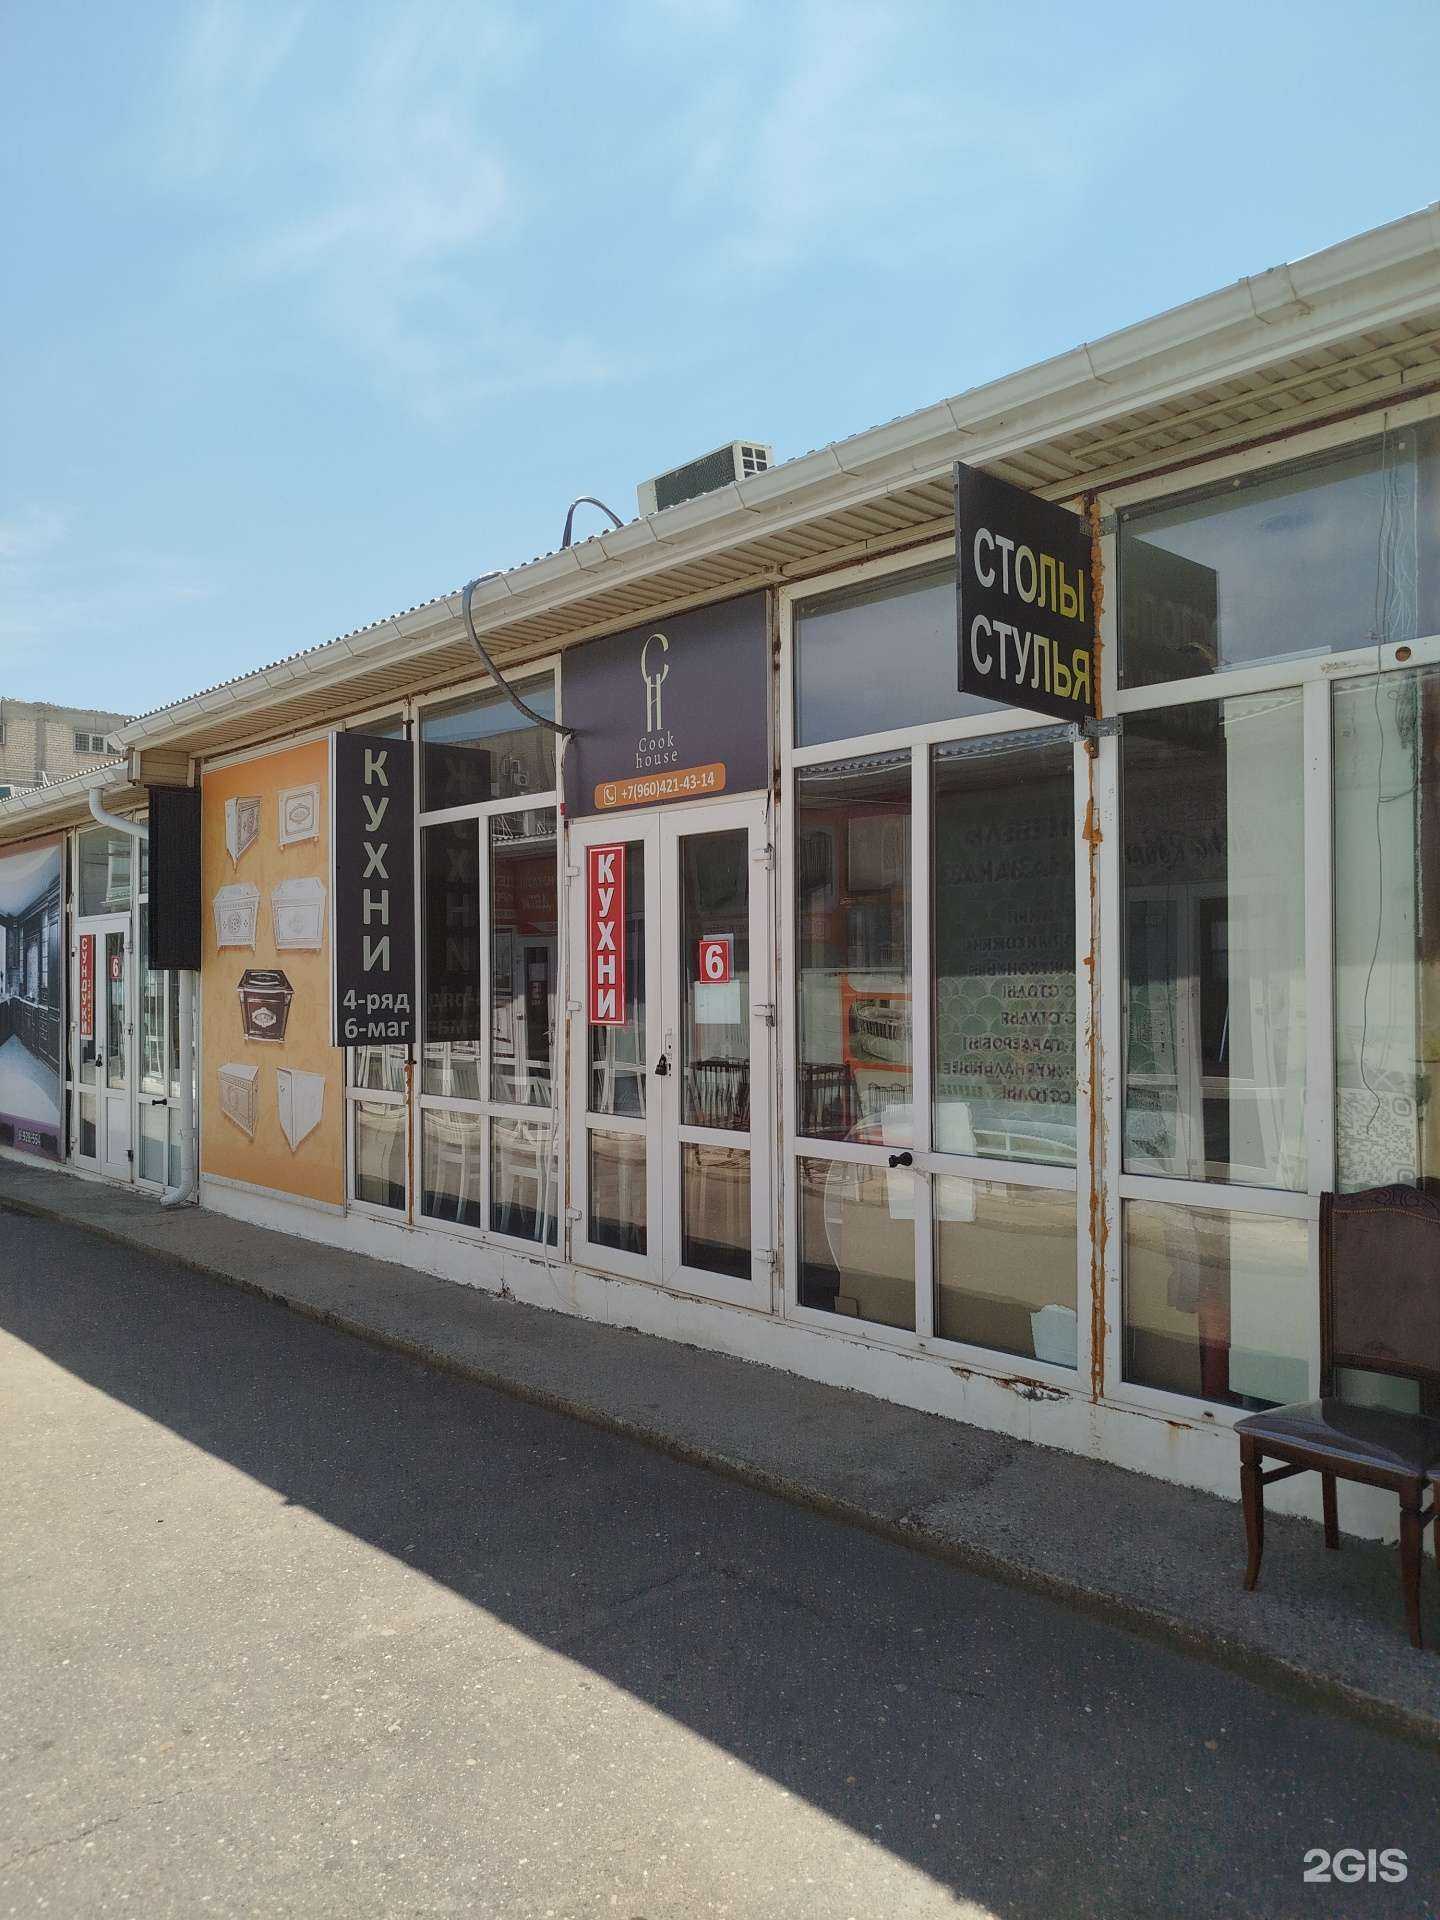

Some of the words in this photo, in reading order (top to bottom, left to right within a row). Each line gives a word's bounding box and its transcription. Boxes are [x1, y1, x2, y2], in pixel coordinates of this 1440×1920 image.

[974, 528, 1084, 622] СТОЛЫ
[971, 614, 1090, 704] СТУЛЬЯ
[638, 731, 674, 753] Cook
[636, 750, 679, 769] house
[621, 771, 716, 800] +7(960)421-43-14
[362, 749, 390, 971] КУХНИ
[597, 854, 616, 1018] КУХНИ
[112, 958, 118, 976] 6
[706, 945, 724, 979] 6
[343, 989, 410, 1014] 4-ряд
[344, 1018, 409, 1039] 6-маг
